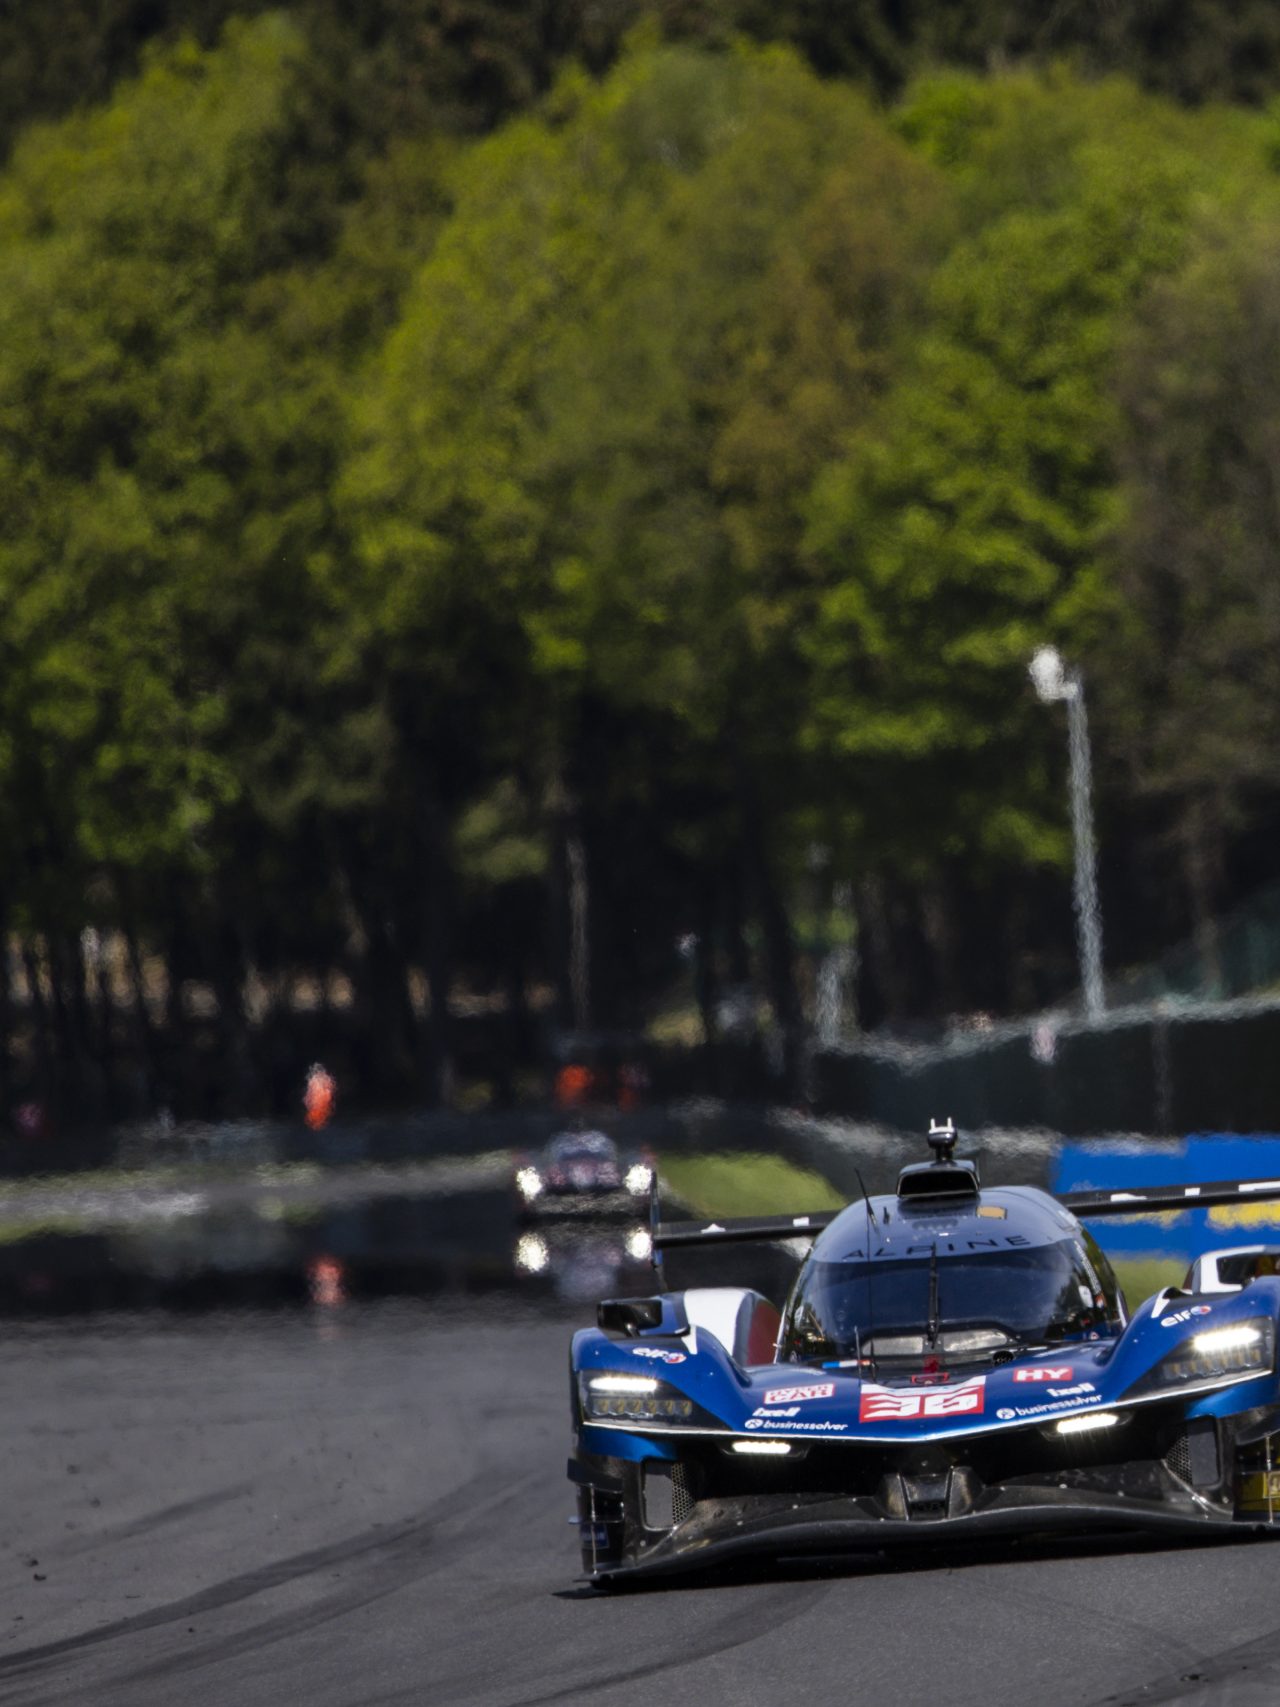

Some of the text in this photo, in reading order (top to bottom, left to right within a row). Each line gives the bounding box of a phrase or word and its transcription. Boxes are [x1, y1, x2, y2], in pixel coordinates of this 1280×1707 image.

[842, 1234, 1031, 1261] ALPINE
[1161, 1309, 1191, 1328] elf
[1016, 1368, 1070, 1380] HY
[863, 1387, 981, 1418] 36
[1015, 1394, 1103, 1417] businessolver
[762, 1420, 848, 1431] businessolver
